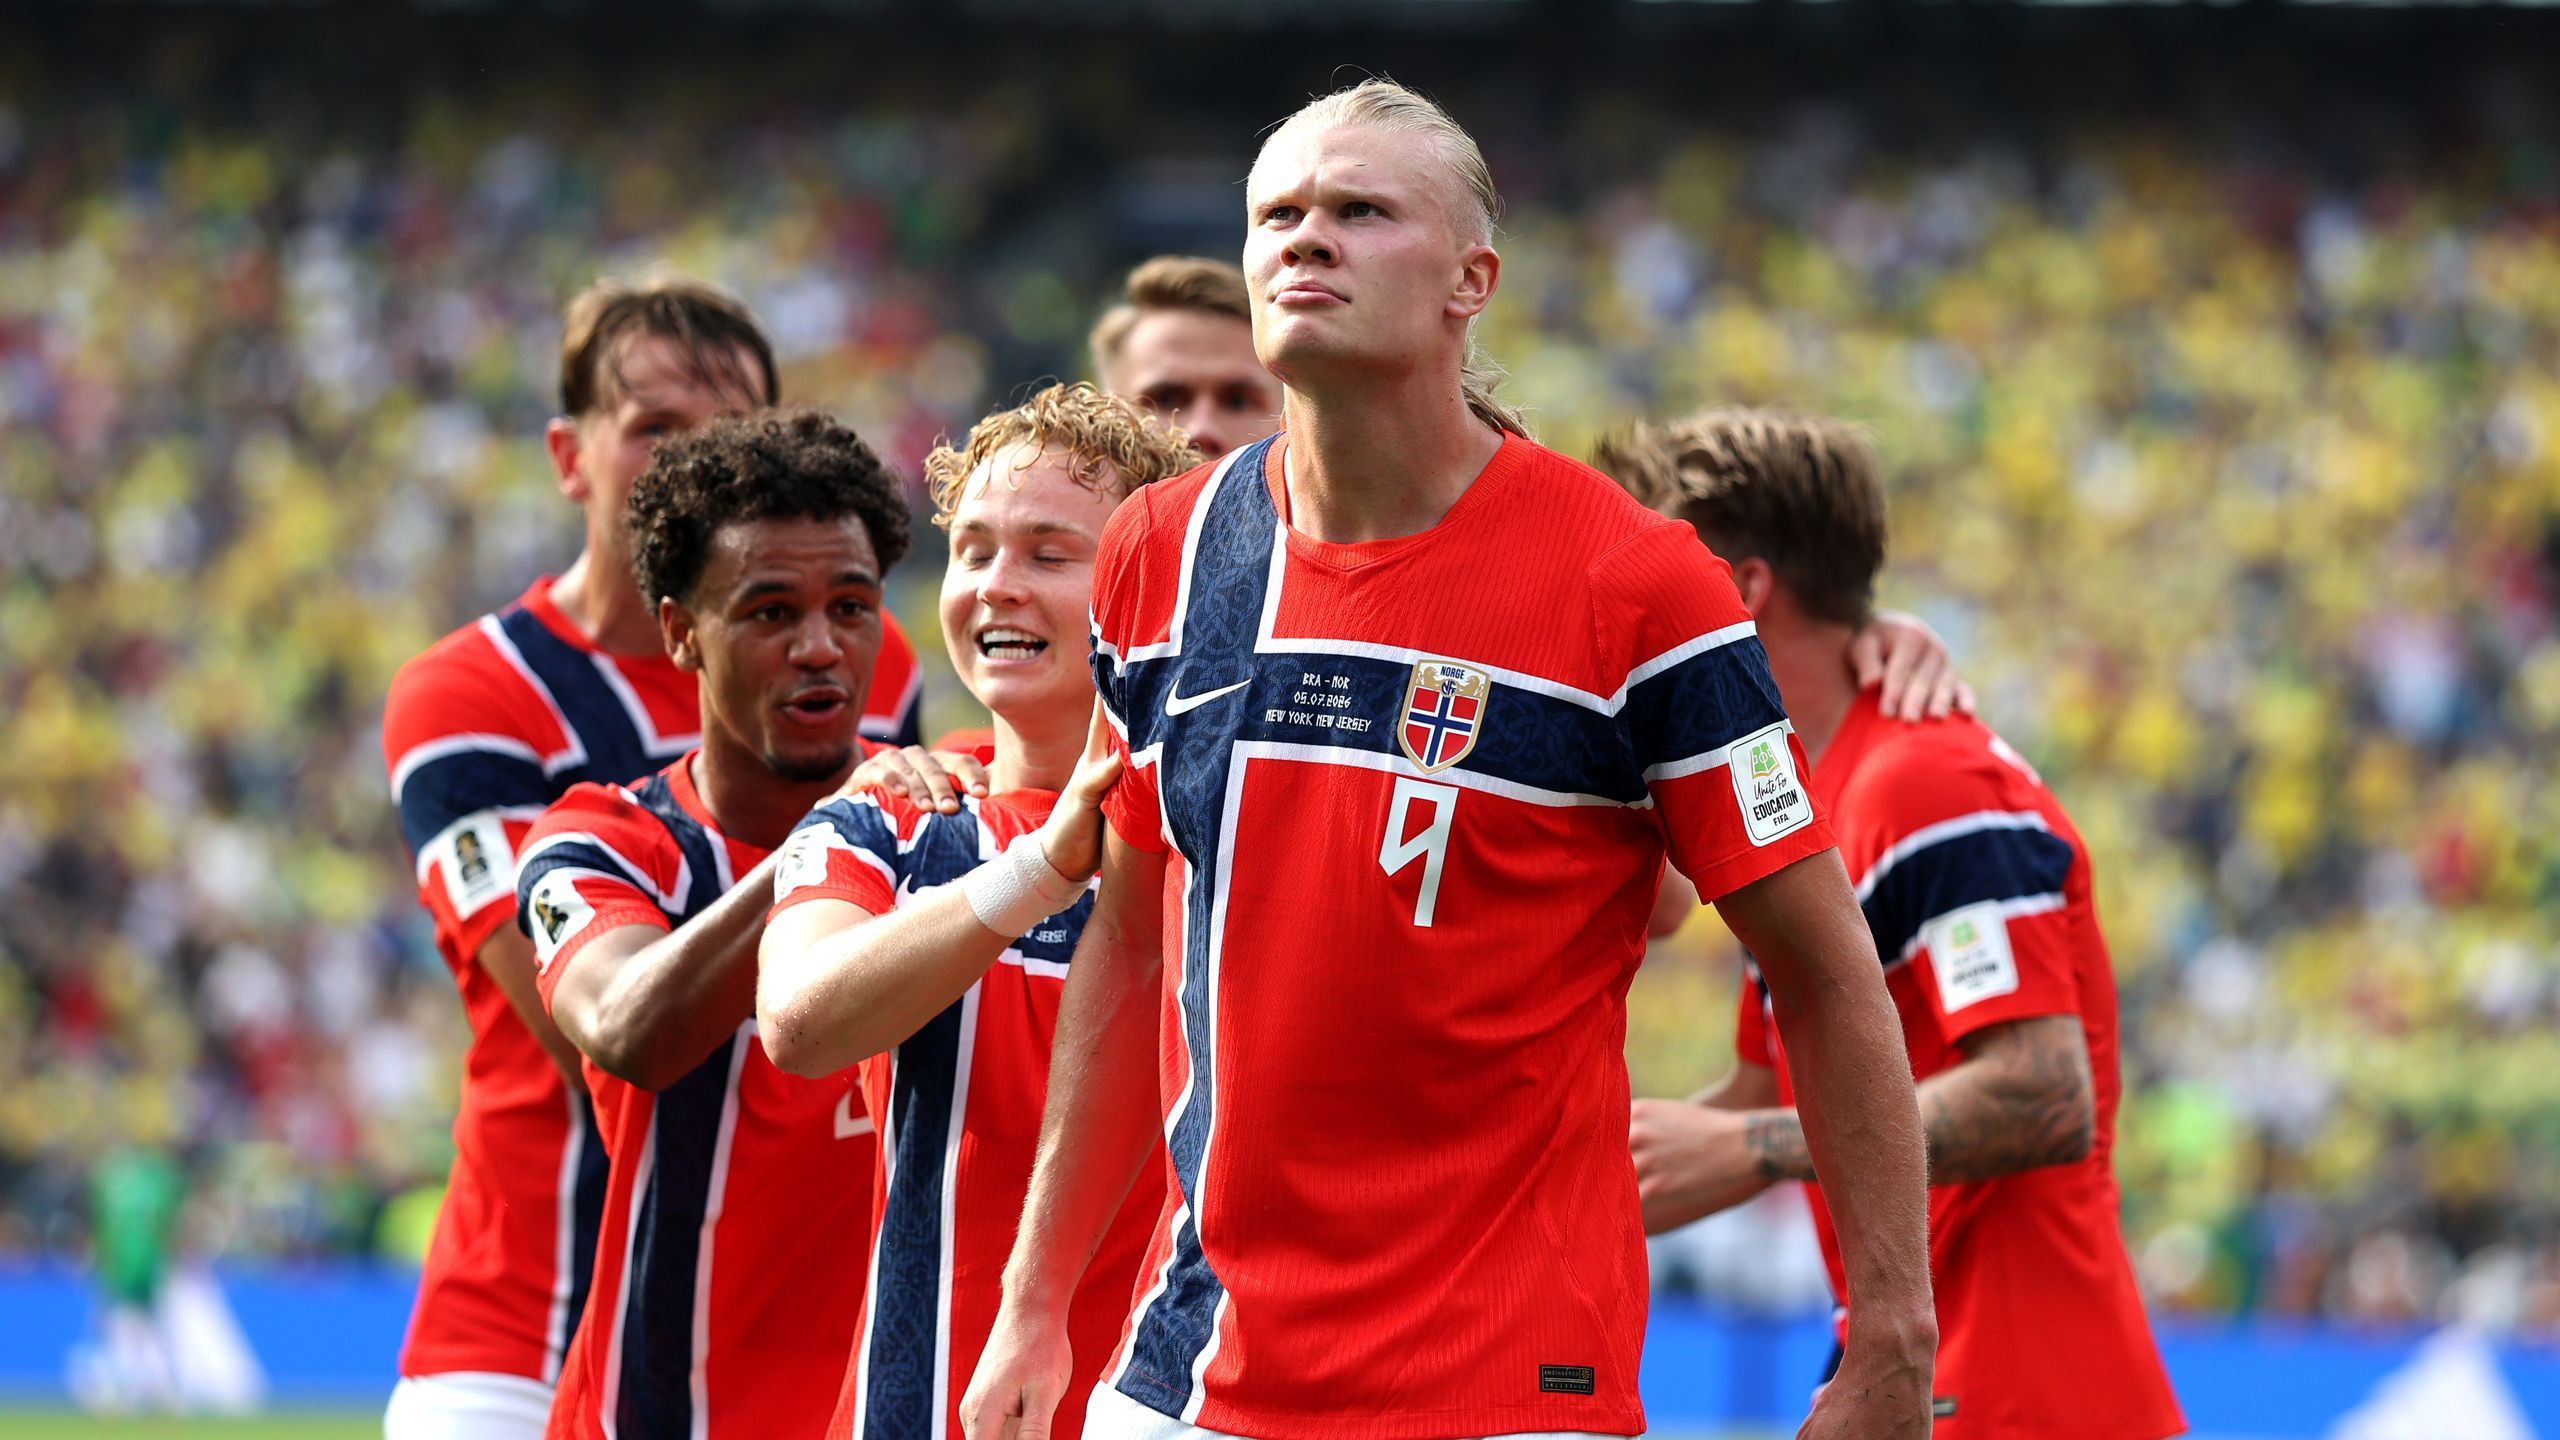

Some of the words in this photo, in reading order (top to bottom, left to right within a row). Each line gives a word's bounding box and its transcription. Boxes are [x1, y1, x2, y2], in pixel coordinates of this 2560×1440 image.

[1302, 672, 1321, 687] BRA
[1331, 675, 1350, 690] NOR
[1441, 666, 1466, 680] NORGE
[1293, 691, 1352, 709] 05.07.2026
[1264, 708, 1287, 723] NEW
[1288, 710, 1315, 726] YORK
[1315, 714, 1335, 728] NEW
[1335, 715, 1372, 732] JERSEY
[1753, 778, 1776, 800] Unite
[1752, 788, 1799, 821] EDUCATION
[1772, 813, 1790, 827] FIFA
[1378, 775, 1460, 928] 9
